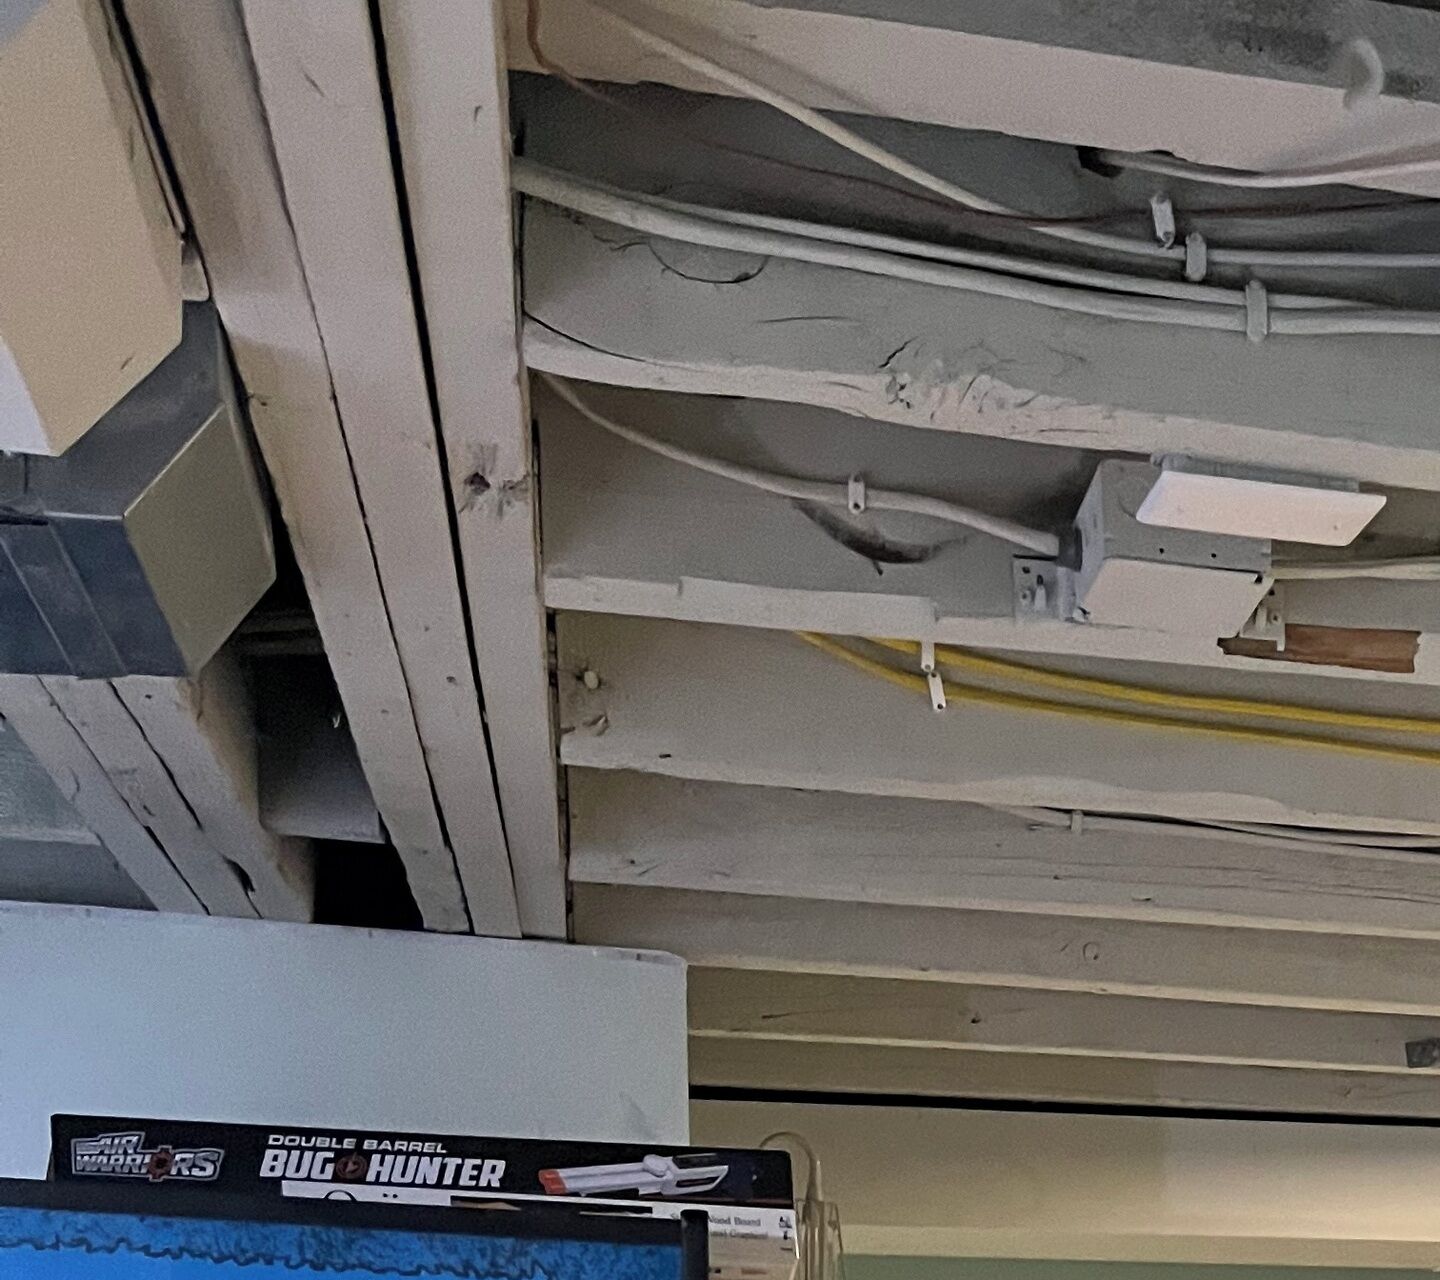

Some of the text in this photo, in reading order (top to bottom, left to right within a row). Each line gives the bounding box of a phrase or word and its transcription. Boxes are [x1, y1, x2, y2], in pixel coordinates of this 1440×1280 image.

[267, 1134, 447, 1153] DOUBLE BARREL
[259, 1149, 506, 1188] BUG HUNTER
